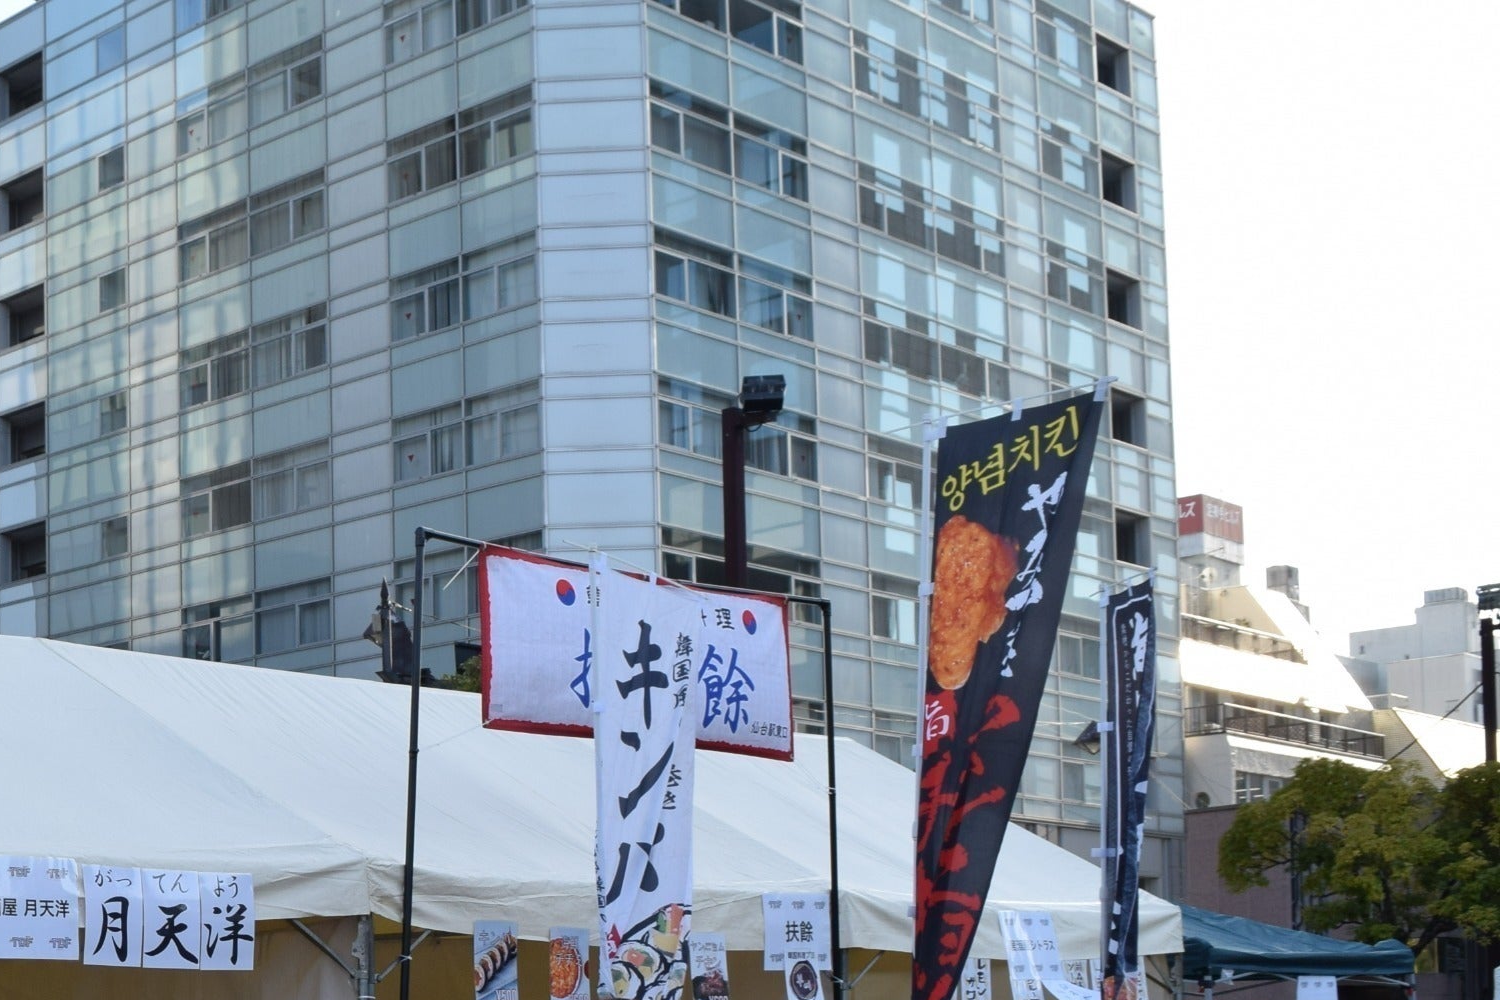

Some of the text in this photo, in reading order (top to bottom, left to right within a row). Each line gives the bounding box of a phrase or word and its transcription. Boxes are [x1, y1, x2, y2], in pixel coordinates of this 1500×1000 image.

[942, 406, 1080, 511] 양념치킨
[24, 899, 69, 918] 月天洋
[93, 896, 255, 966] 月天洋
